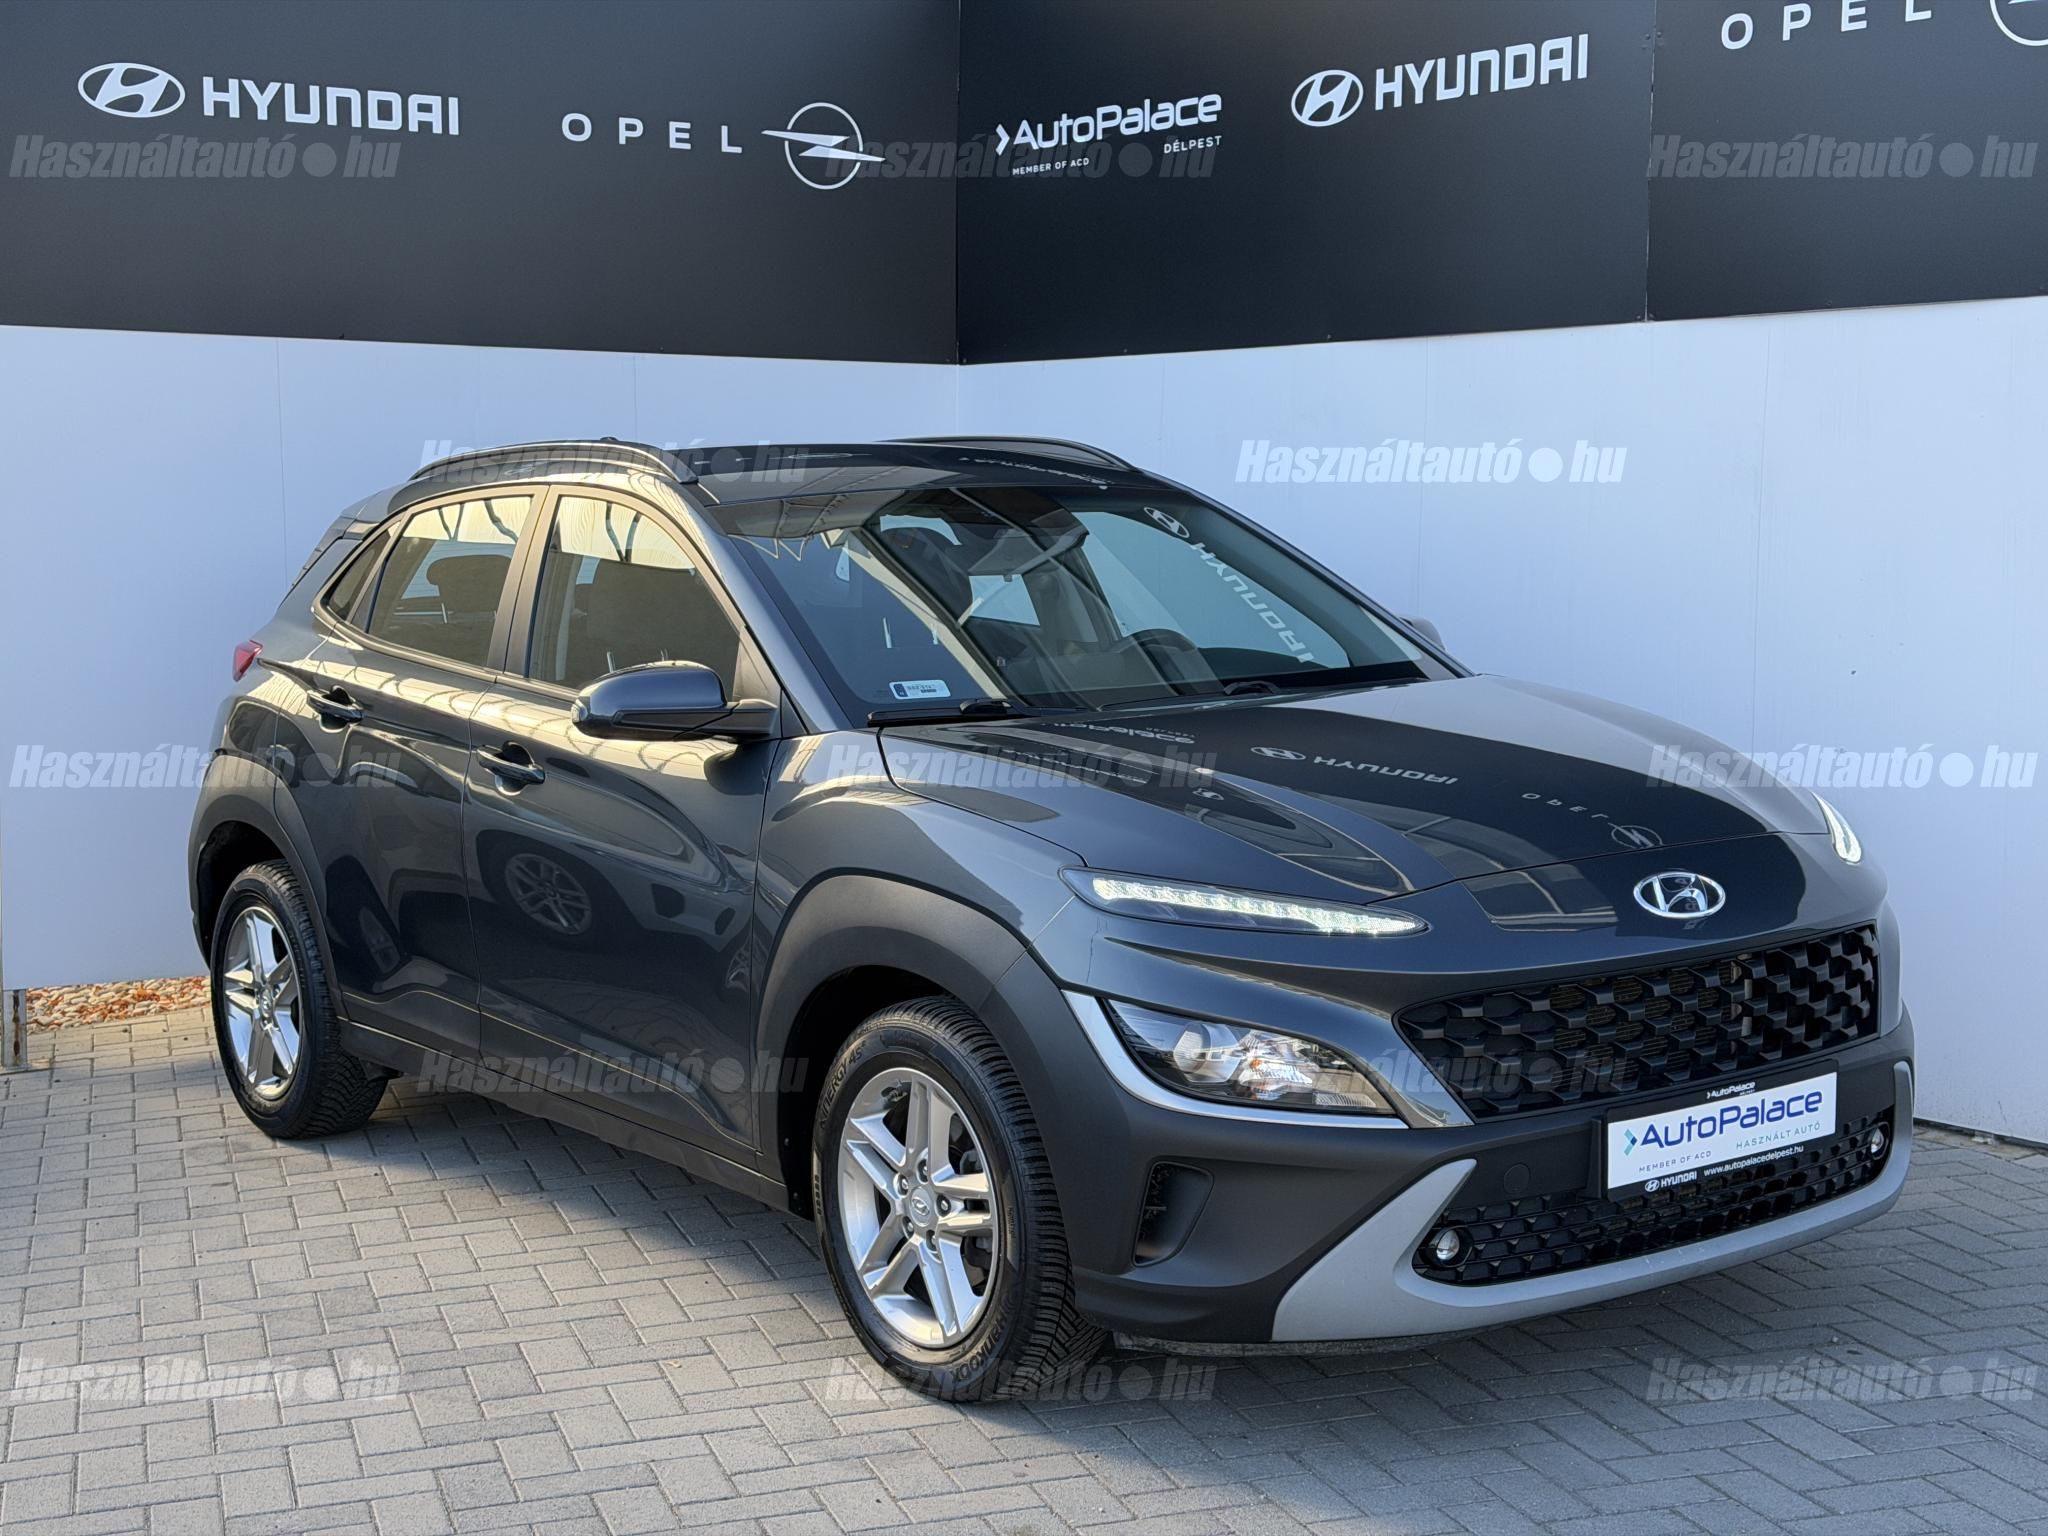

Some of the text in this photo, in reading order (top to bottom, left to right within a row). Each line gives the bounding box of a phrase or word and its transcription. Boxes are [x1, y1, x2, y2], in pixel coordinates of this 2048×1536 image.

[1721, 0, 1932, 50] OPEL
[1375, 33, 1589, 111] HYUNDAI
[202, 76, 460, 136] HYUNDAI
[1013, 93, 1222, 150] AutoPalace
[561, 113, 743, 153] OPEL
[1163, 135, 1222, 154] DÉLPEST
[1012, 158, 1090, 176] MEMBER OF ACD
[1640, 1090, 1823, 1148] AutoPalace
[1735, 1121, 1821, 1150] HASZNÁLT AUTÓ
[1639, 1158, 1677, 1172] MEMBER
[1680, 1155, 1691, 1165] OF
[1660, 1144, 1804, 1188] HYUNDAI www.autopalacedelpest.hu
